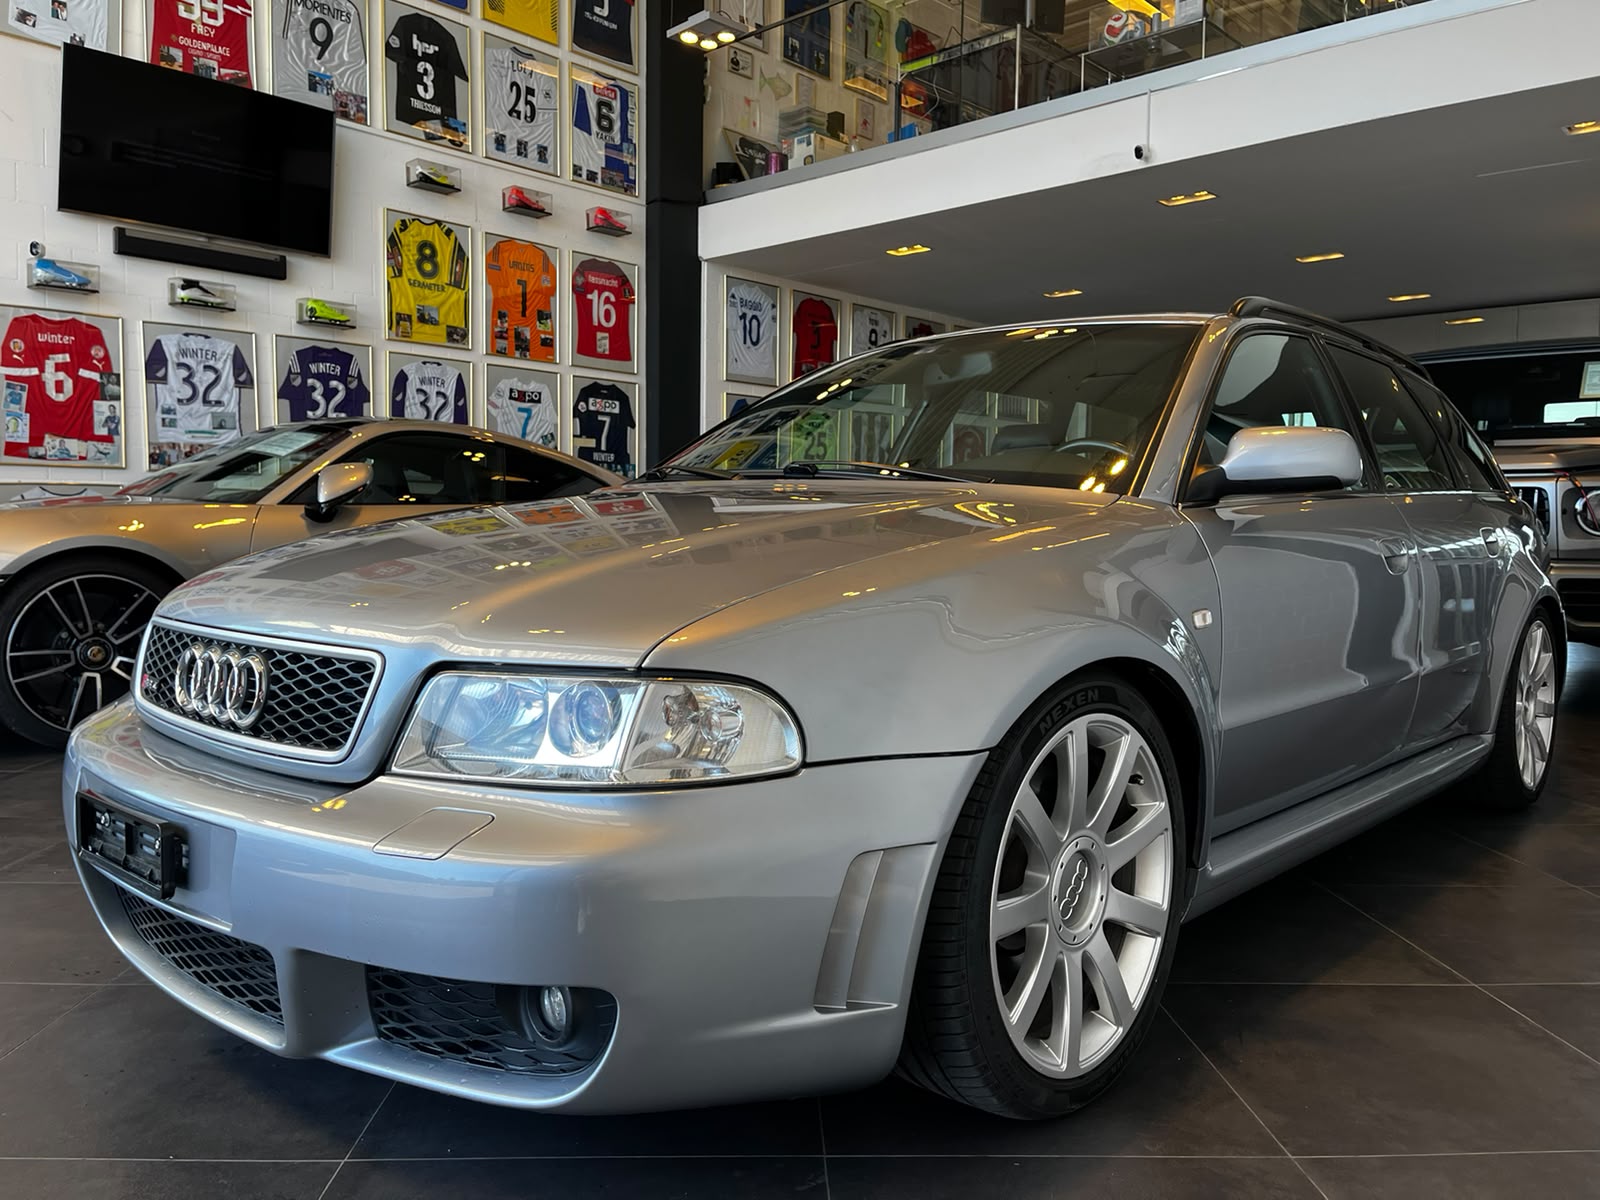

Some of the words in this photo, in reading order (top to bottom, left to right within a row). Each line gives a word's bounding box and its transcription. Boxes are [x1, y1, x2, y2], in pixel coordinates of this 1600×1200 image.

[178, 35, 231, 57] GOLDENPALACE
[190, 23, 216, 38] FREY
[309, 17, 334, 61] 9
[416, 61, 435, 100] 3
[508, 80, 537, 124] 25
[596, 98, 615, 134] 6
[415, 240, 439, 280] 8
[516, 279, 527, 318] 1
[586, 289, 617, 328] 16
[37, 332, 76, 345] winter
[738, 312, 761, 347] 10
[178, 347, 218, 362] WINTER
[308, 362, 341, 377] WINTER
[41, 353, 74, 402] 6
[175, 362, 225, 407] 32
[418, 376, 446, 389] WINTER
[306, 378, 347, 419] 32
[516, 406, 533, 439] 7
[597, 414, 611, 451] 7
[1039, 688, 1099, 737] NEXEN
